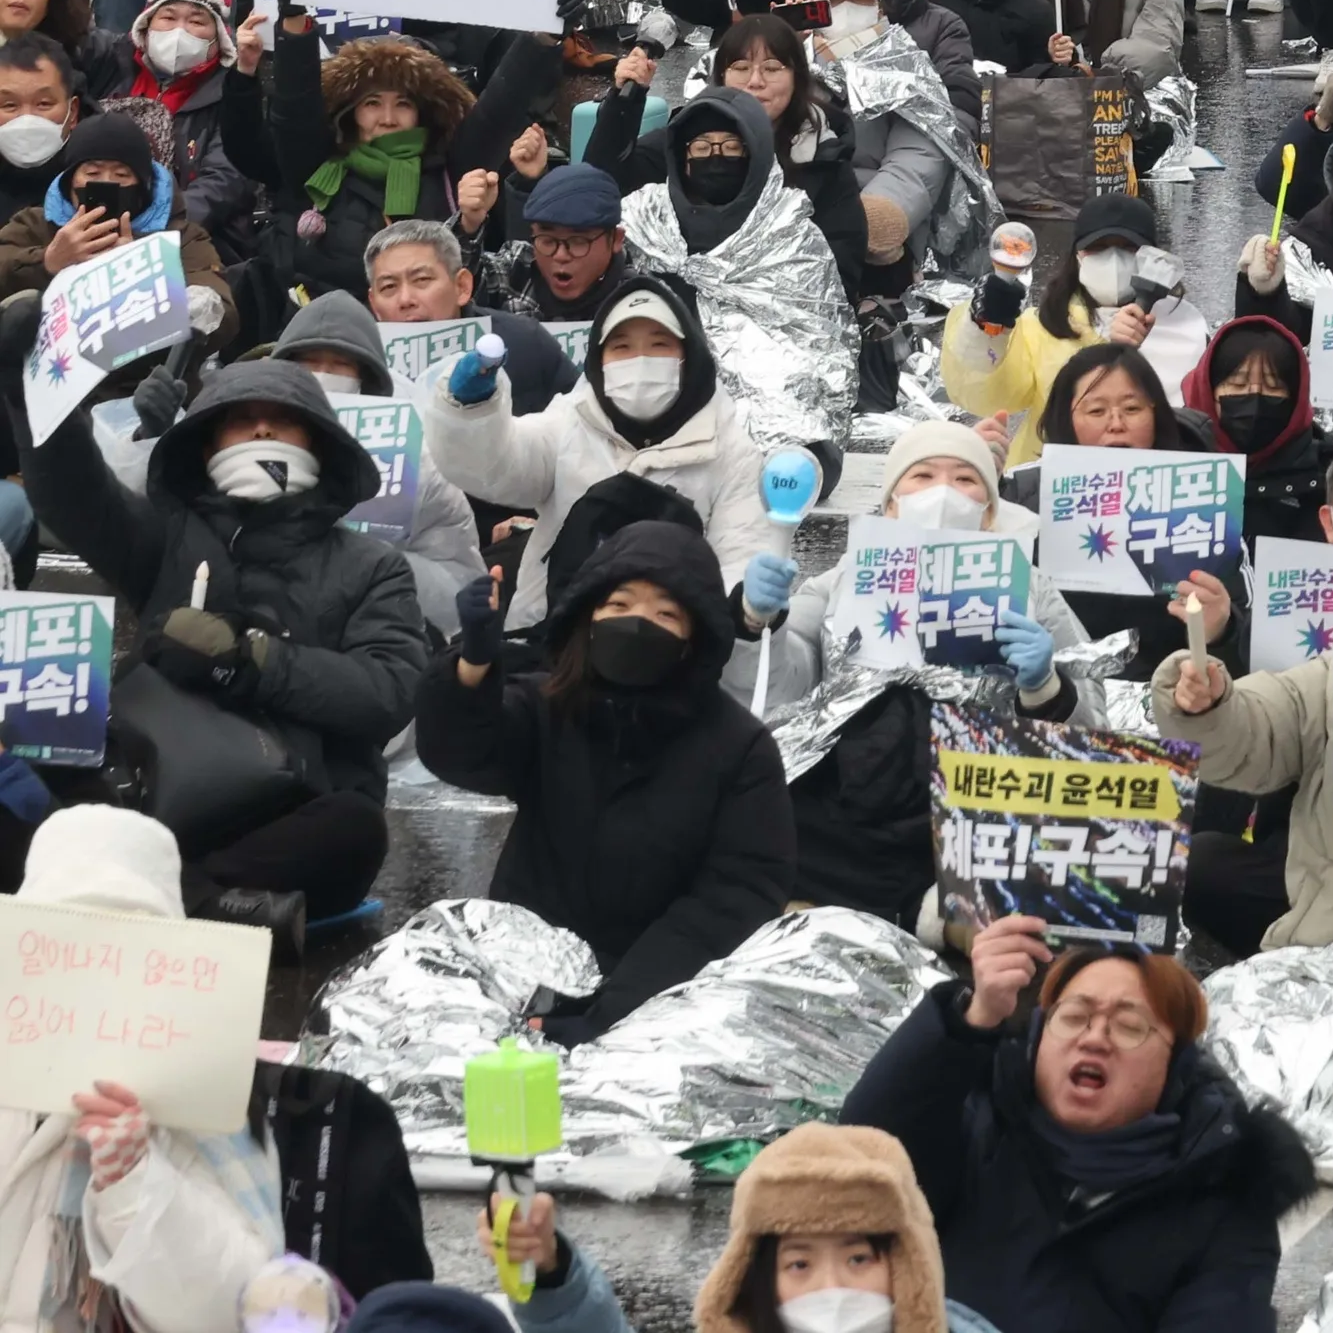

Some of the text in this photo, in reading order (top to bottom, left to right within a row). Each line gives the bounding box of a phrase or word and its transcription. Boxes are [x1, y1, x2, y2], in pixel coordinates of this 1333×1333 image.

[66, 235, 165, 319] 체포!
[75, 286, 172, 352] 구속!
[1052, 470, 1124, 496] 내란수괴
[1052, 493, 1122, 521] 윤석열
[1128, 458, 1229, 514] 체포!
[855, 547, 918, 570] 내란수괴
[1128, 514, 1225, 565] 구속!
[855, 567, 918, 594] 윤석열
[920, 543, 1014, 596] 체포!
[954, 766, 1161, 811] 내란수괴 윤석열
